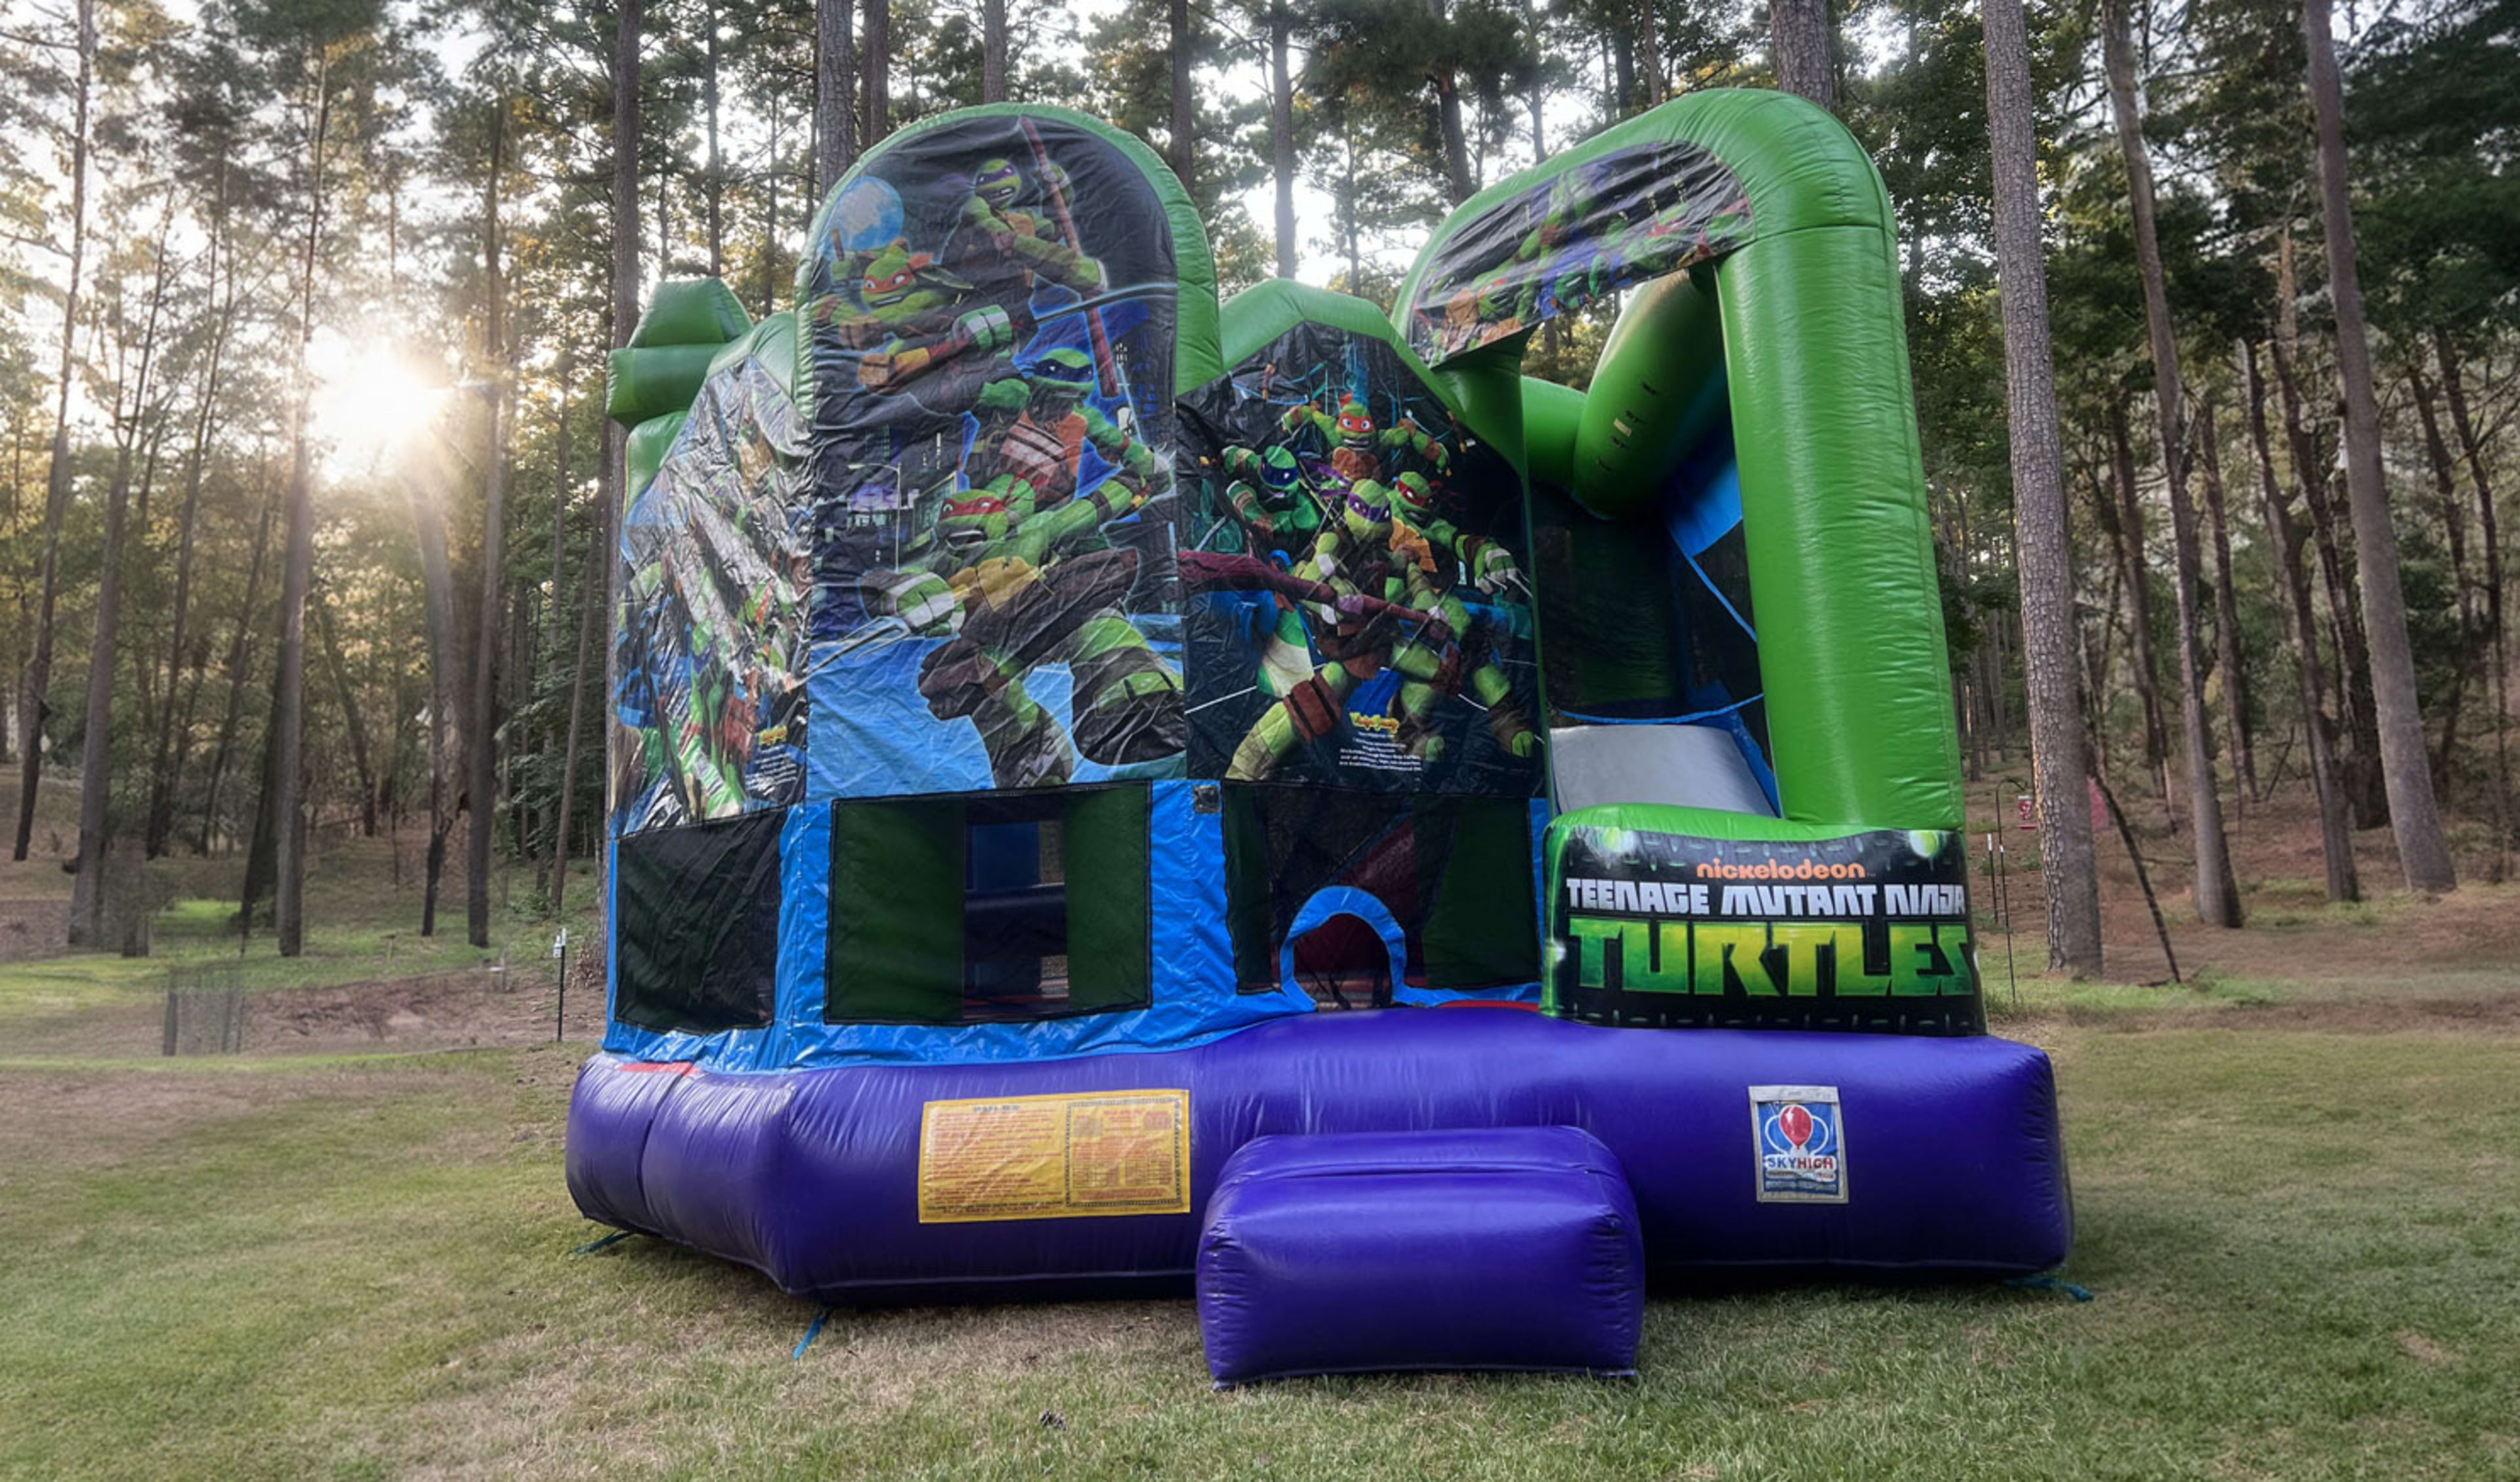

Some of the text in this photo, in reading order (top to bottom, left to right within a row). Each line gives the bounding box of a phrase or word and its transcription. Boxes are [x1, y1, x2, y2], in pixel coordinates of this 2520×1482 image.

[1696, 858, 1866, 880] nickelodeon
[1566, 878, 1966, 916] TEENAGE MUTANT NINJA
[1569, 918, 1974, 996] TURTLES
[1767, 1156, 1834, 1170] SKYHIGH
